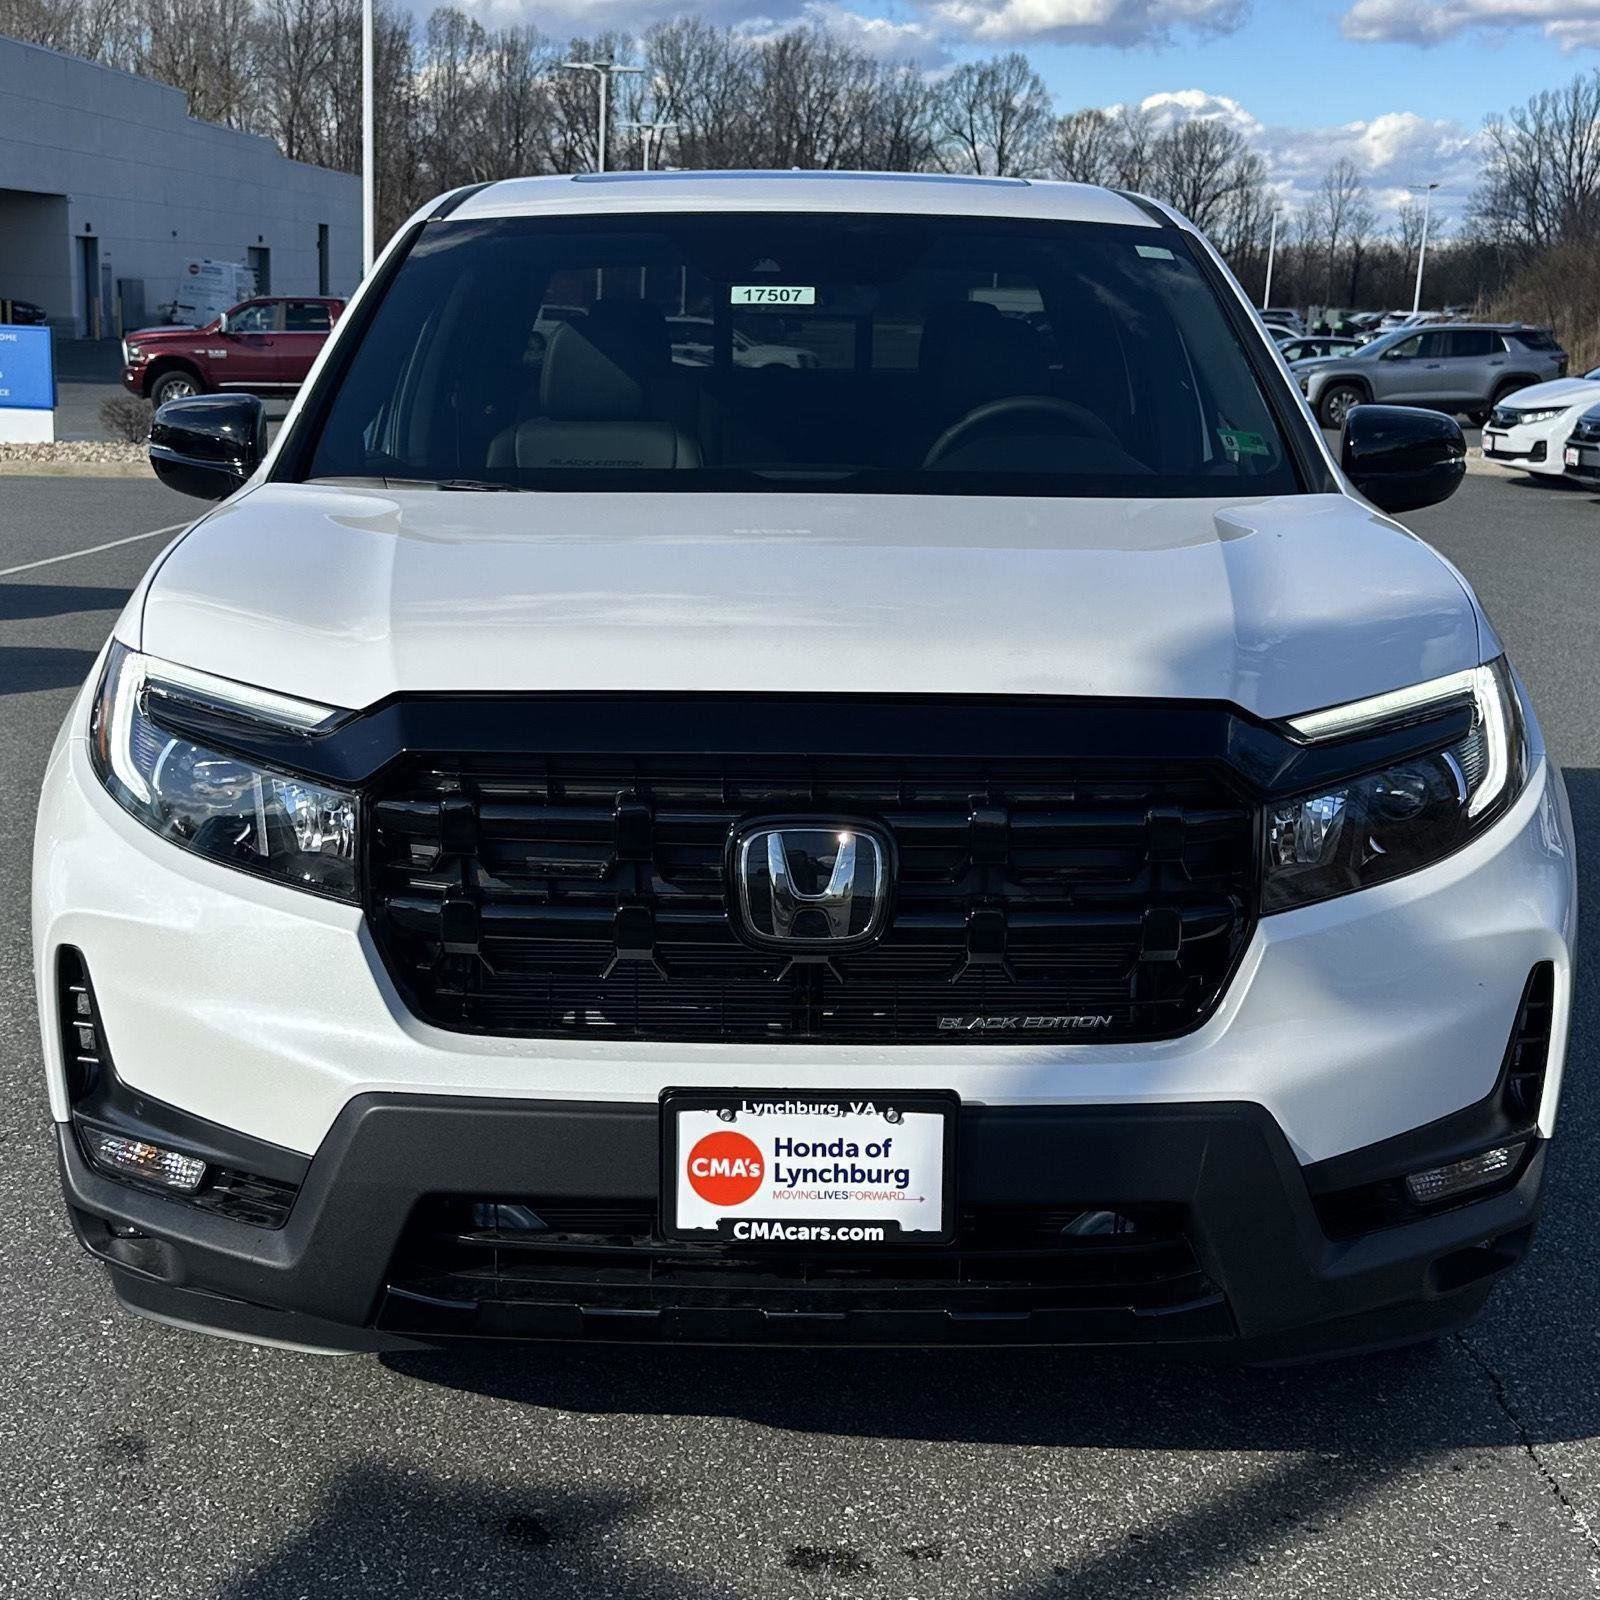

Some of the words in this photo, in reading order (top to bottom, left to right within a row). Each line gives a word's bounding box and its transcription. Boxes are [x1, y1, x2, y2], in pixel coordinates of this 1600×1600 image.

[743, 289, 802, 302] 17507
[938, 1017, 1020, 1030] BLACK
[1022, 1015, 1113, 1029] EDITION
[742, 1100, 844, 1117] Lynchburg,
[850, 1102, 877, 1115] VA
[774, 1137, 859, 1158] Honda
[865, 1137, 892, 1158] of
[691, 1158, 761, 1178] CMA's
[774, 1163, 910, 1189] Lynchburg
[733, 1221, 884, 1241] CMAcars.com
